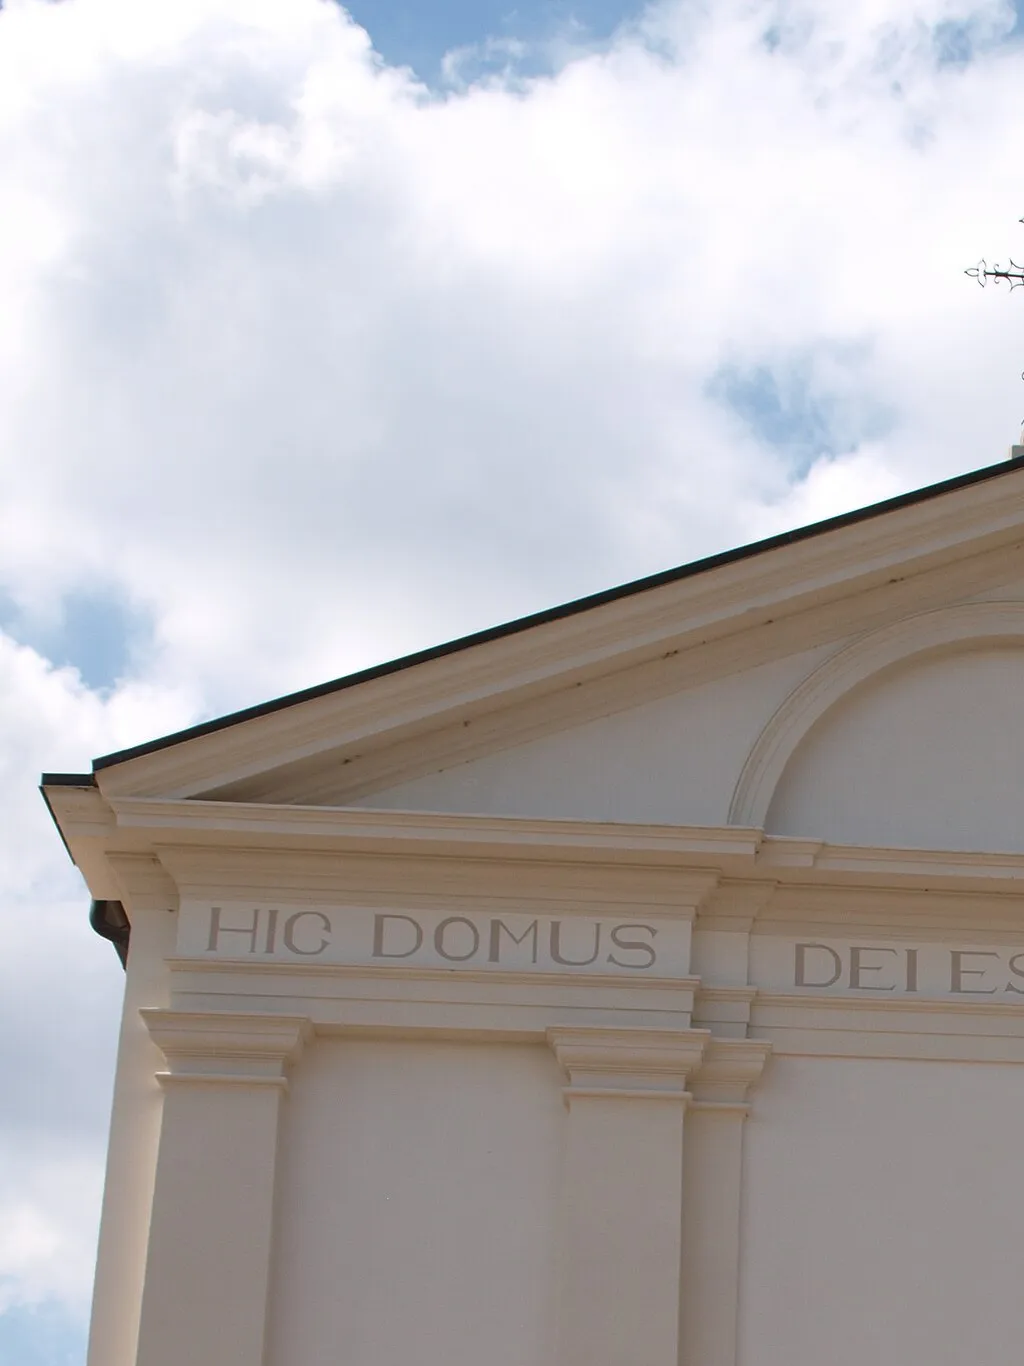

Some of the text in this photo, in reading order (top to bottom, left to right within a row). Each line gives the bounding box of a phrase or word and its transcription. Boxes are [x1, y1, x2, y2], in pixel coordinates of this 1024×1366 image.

[206, 906, 332, 956] HIC
[372, 913, 658, 969] DOMUS
[795, 942, 919, 993] DEI
